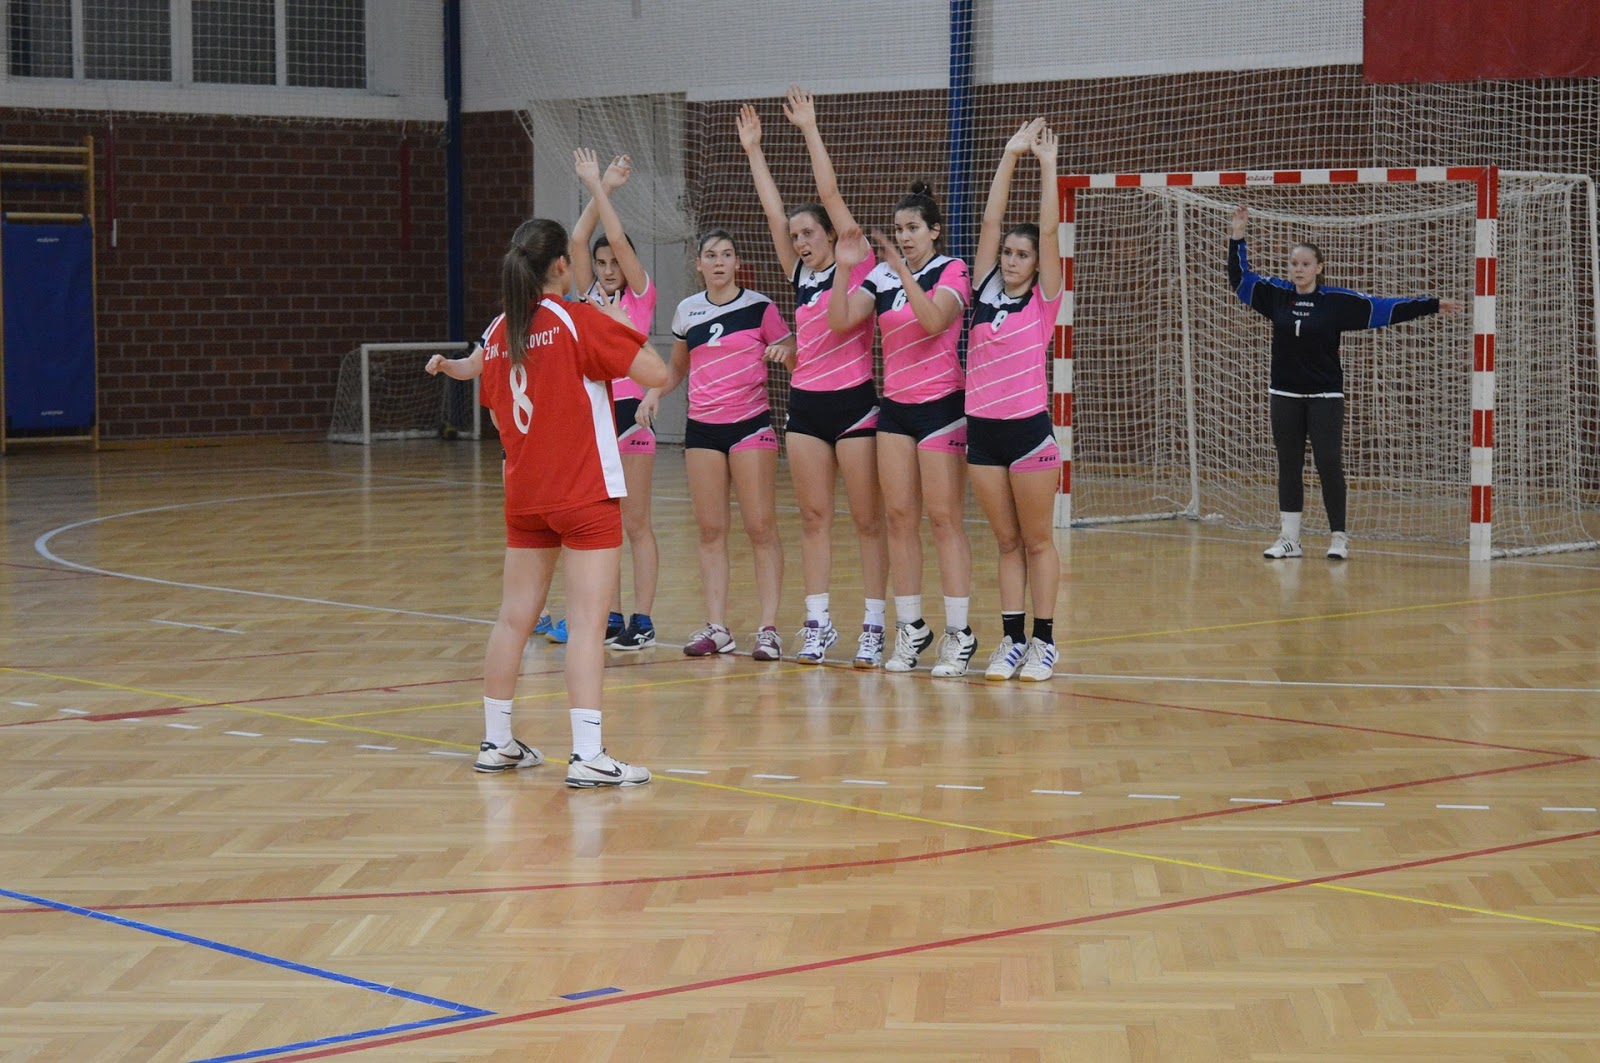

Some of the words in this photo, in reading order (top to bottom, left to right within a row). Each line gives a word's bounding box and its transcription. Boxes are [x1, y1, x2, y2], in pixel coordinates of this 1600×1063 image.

[891, 288, 907, 312] 6
[707, 322, 724, 347] 2
[1294, 319, 1302, 337] 1
[509, 362, 534, 435] 8
